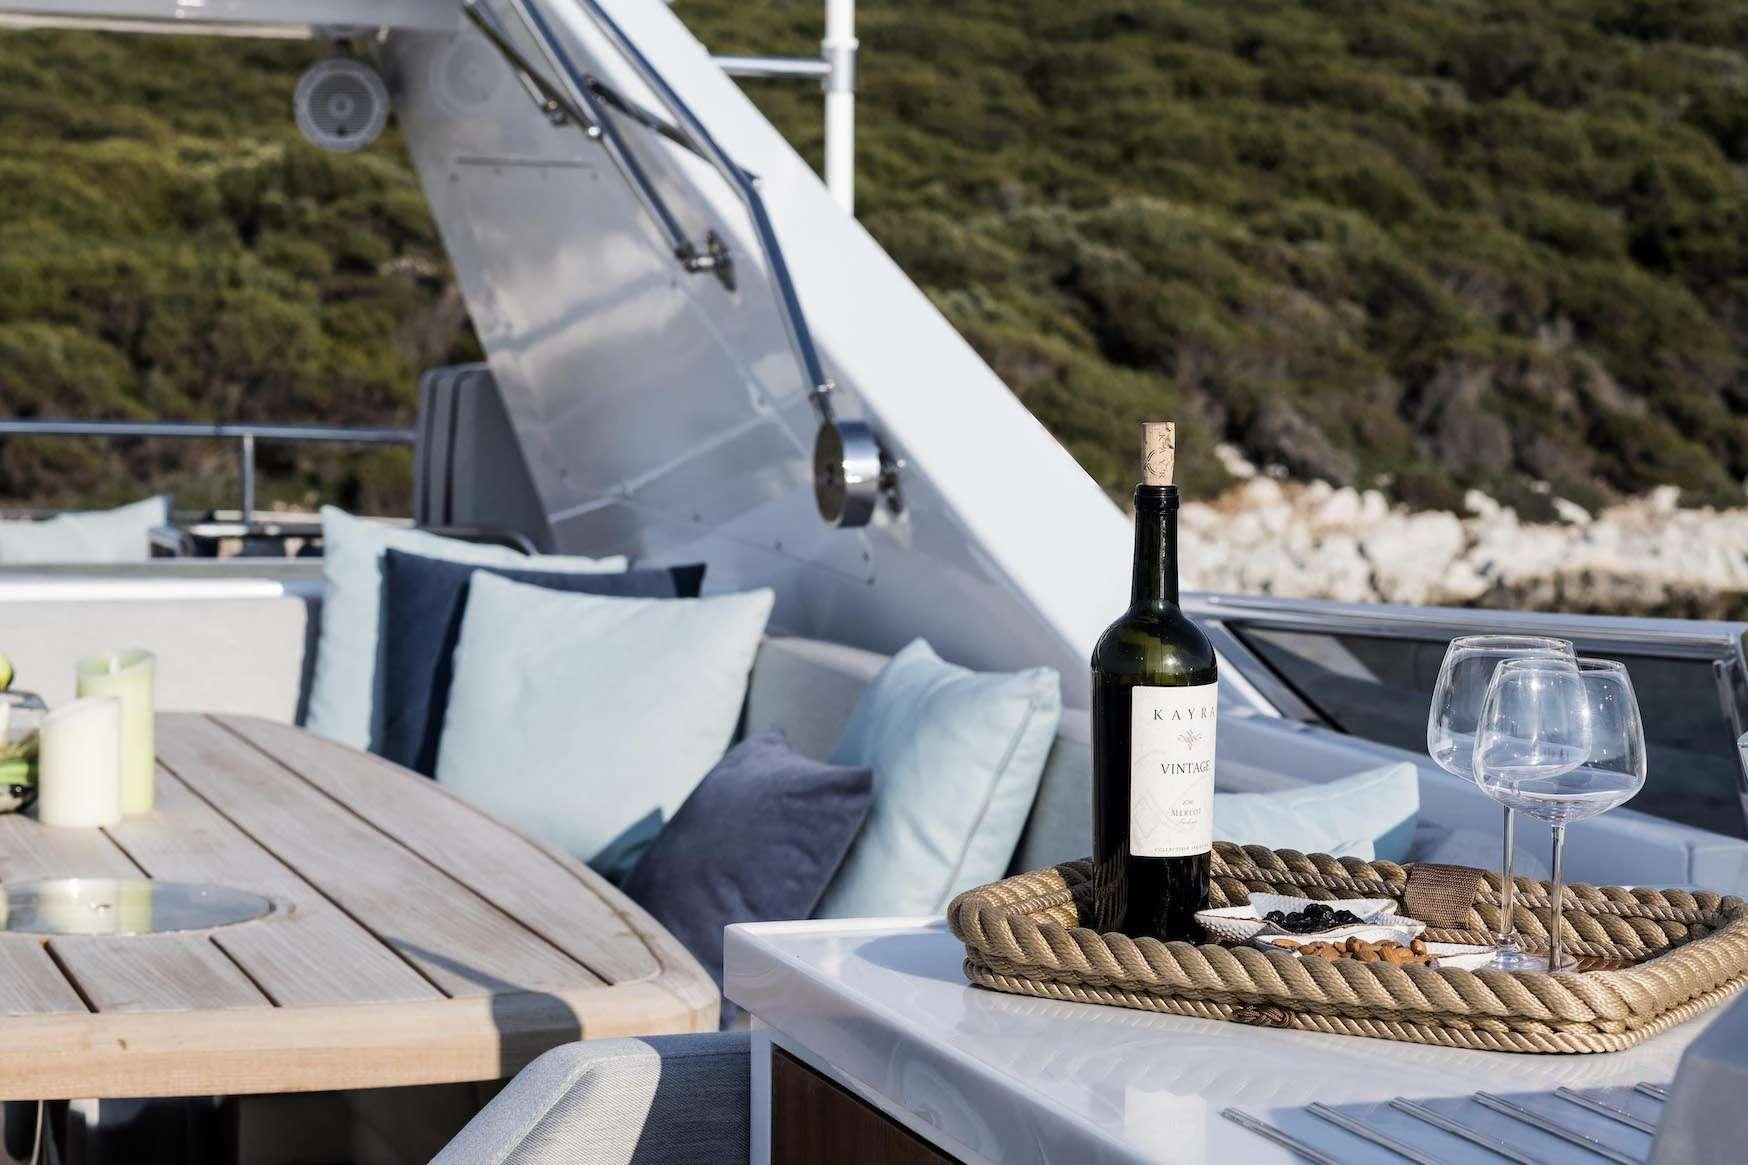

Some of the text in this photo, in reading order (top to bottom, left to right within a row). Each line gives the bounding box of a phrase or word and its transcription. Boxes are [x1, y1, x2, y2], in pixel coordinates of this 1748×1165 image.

[1154, 706, 1215, 721] KAYRA
[1161, 760, 1210, 775] VINTAGE
[1170, 807, 1202, 817] MERLOT
